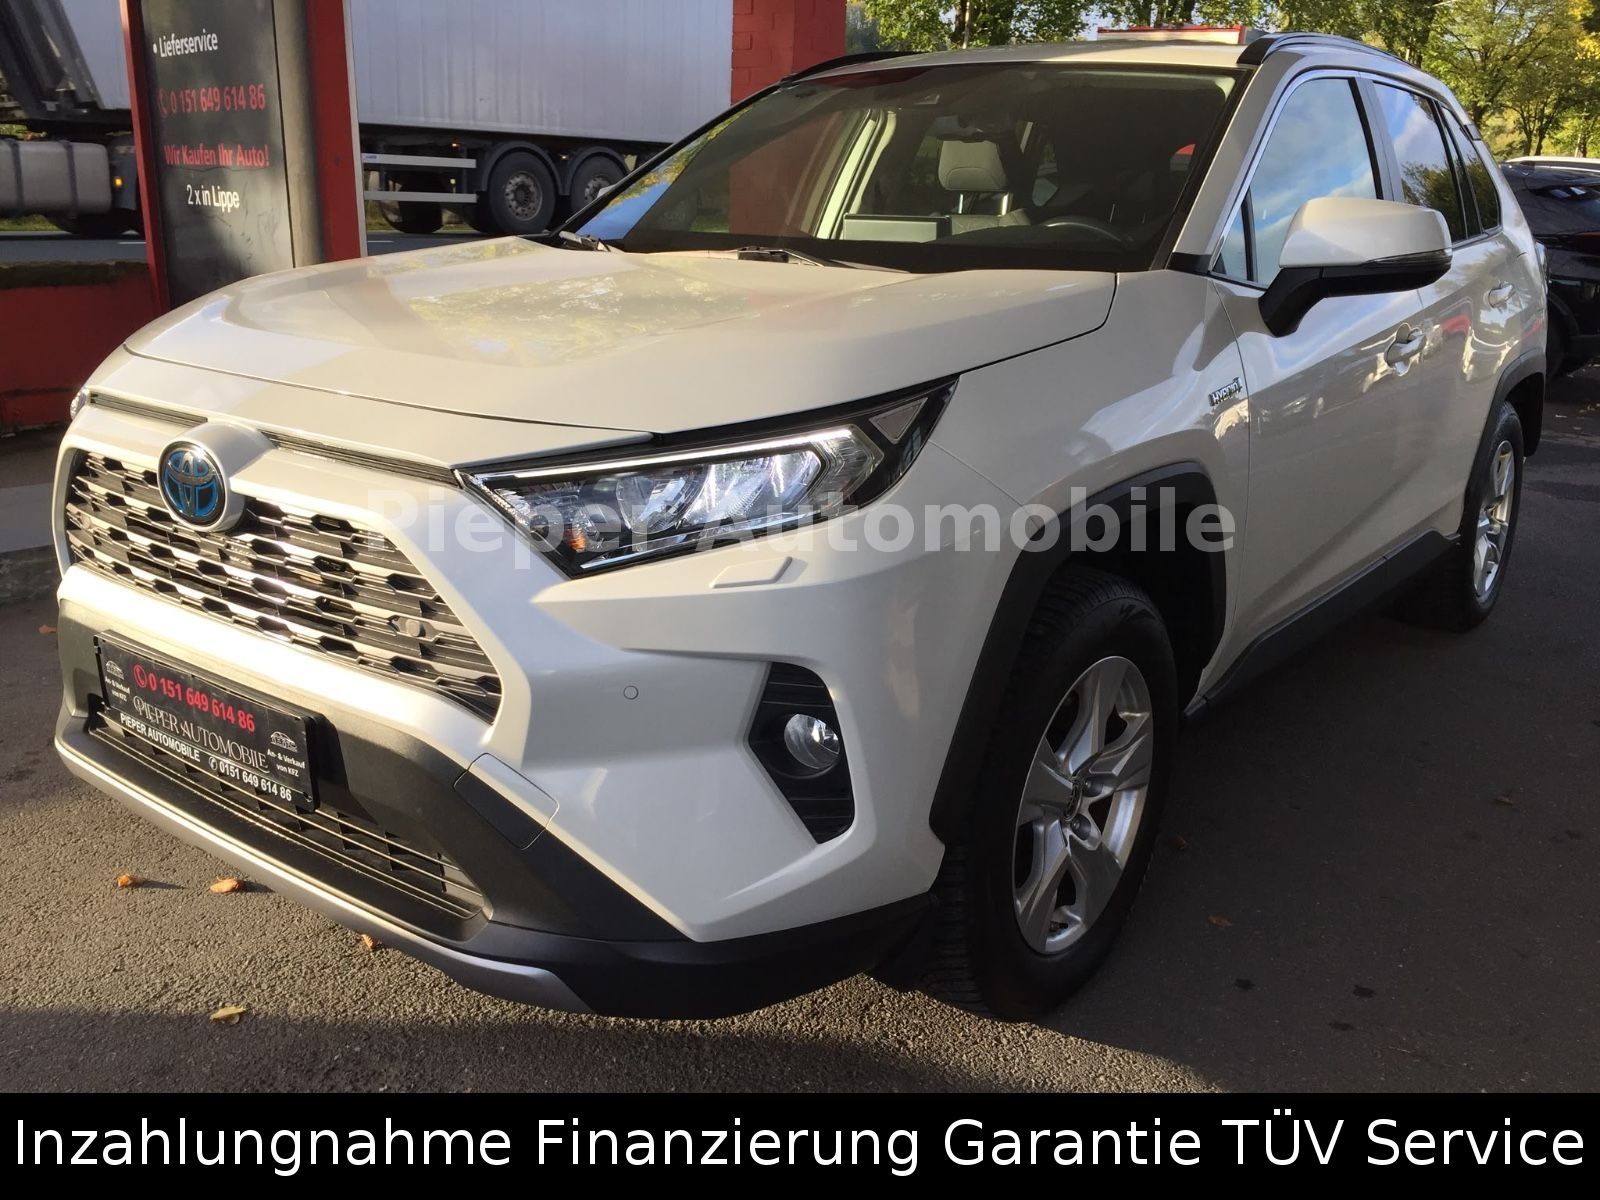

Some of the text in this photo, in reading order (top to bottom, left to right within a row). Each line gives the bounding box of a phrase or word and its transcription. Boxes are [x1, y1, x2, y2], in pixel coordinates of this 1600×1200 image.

[159, 28, 218, 57] Lieferservice
[170, 83, 265, 113] 0 151 649 614 86
[164, 143, 269, 166] Wir Kaufen Ihr Auto!
[186, 184, 240, 213] 2 x in Lippe
[148, 672, 255, 734] 0 151 649 614 86
[120, 712, 201, 763] PIEPER AUTOMOBILE
[133, 695, 270, 774] PIEPER AUTOMOBILE
[283, 755, 305, 769] Verkauf
[219, 762, 292, 802] 0151 649 614 86
